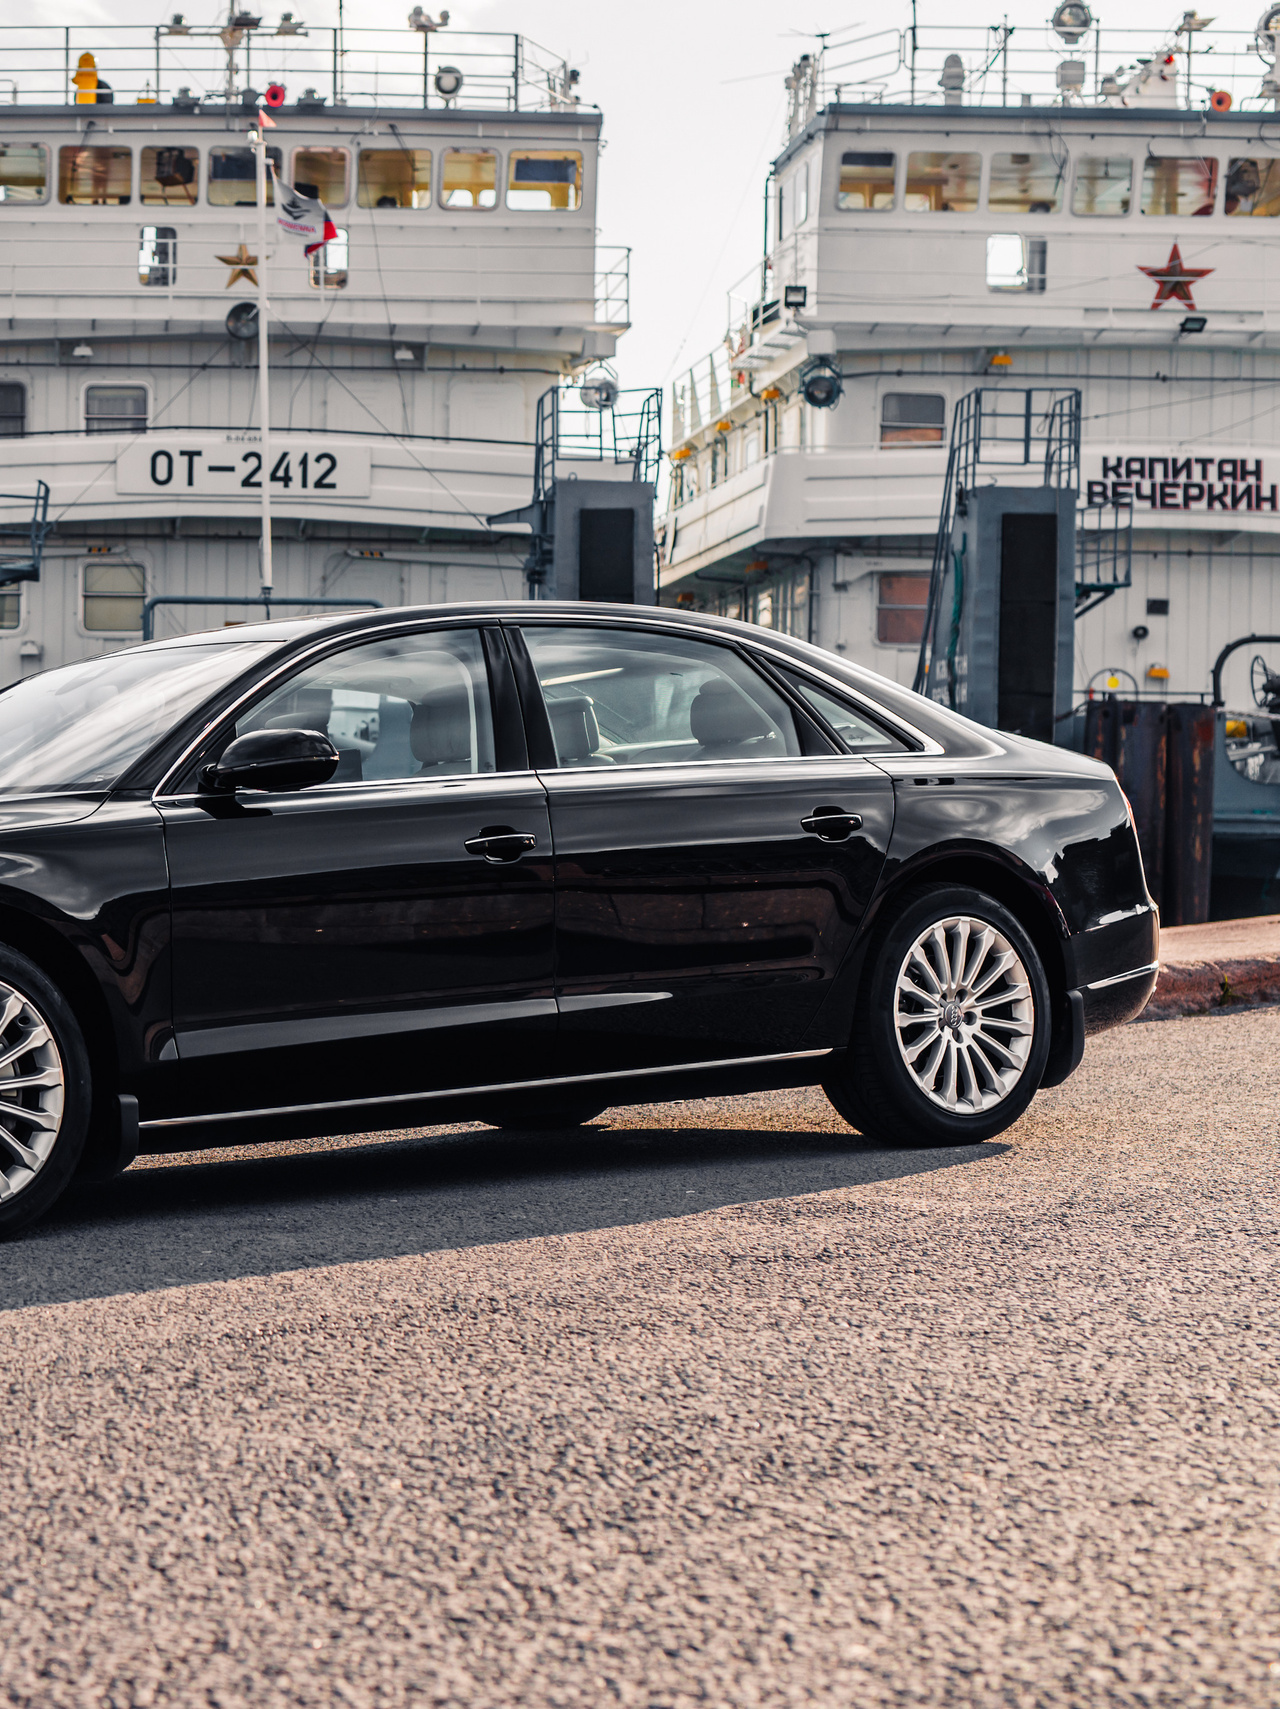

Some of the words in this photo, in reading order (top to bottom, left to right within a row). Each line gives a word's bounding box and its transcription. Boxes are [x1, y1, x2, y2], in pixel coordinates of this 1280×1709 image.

[151, 450, 337, 489] ОТ-2412
[1102, 456, 1263, 482] КАПИТАН
[1087, 481, 1279, 511] ВЕЧЕРКИН
